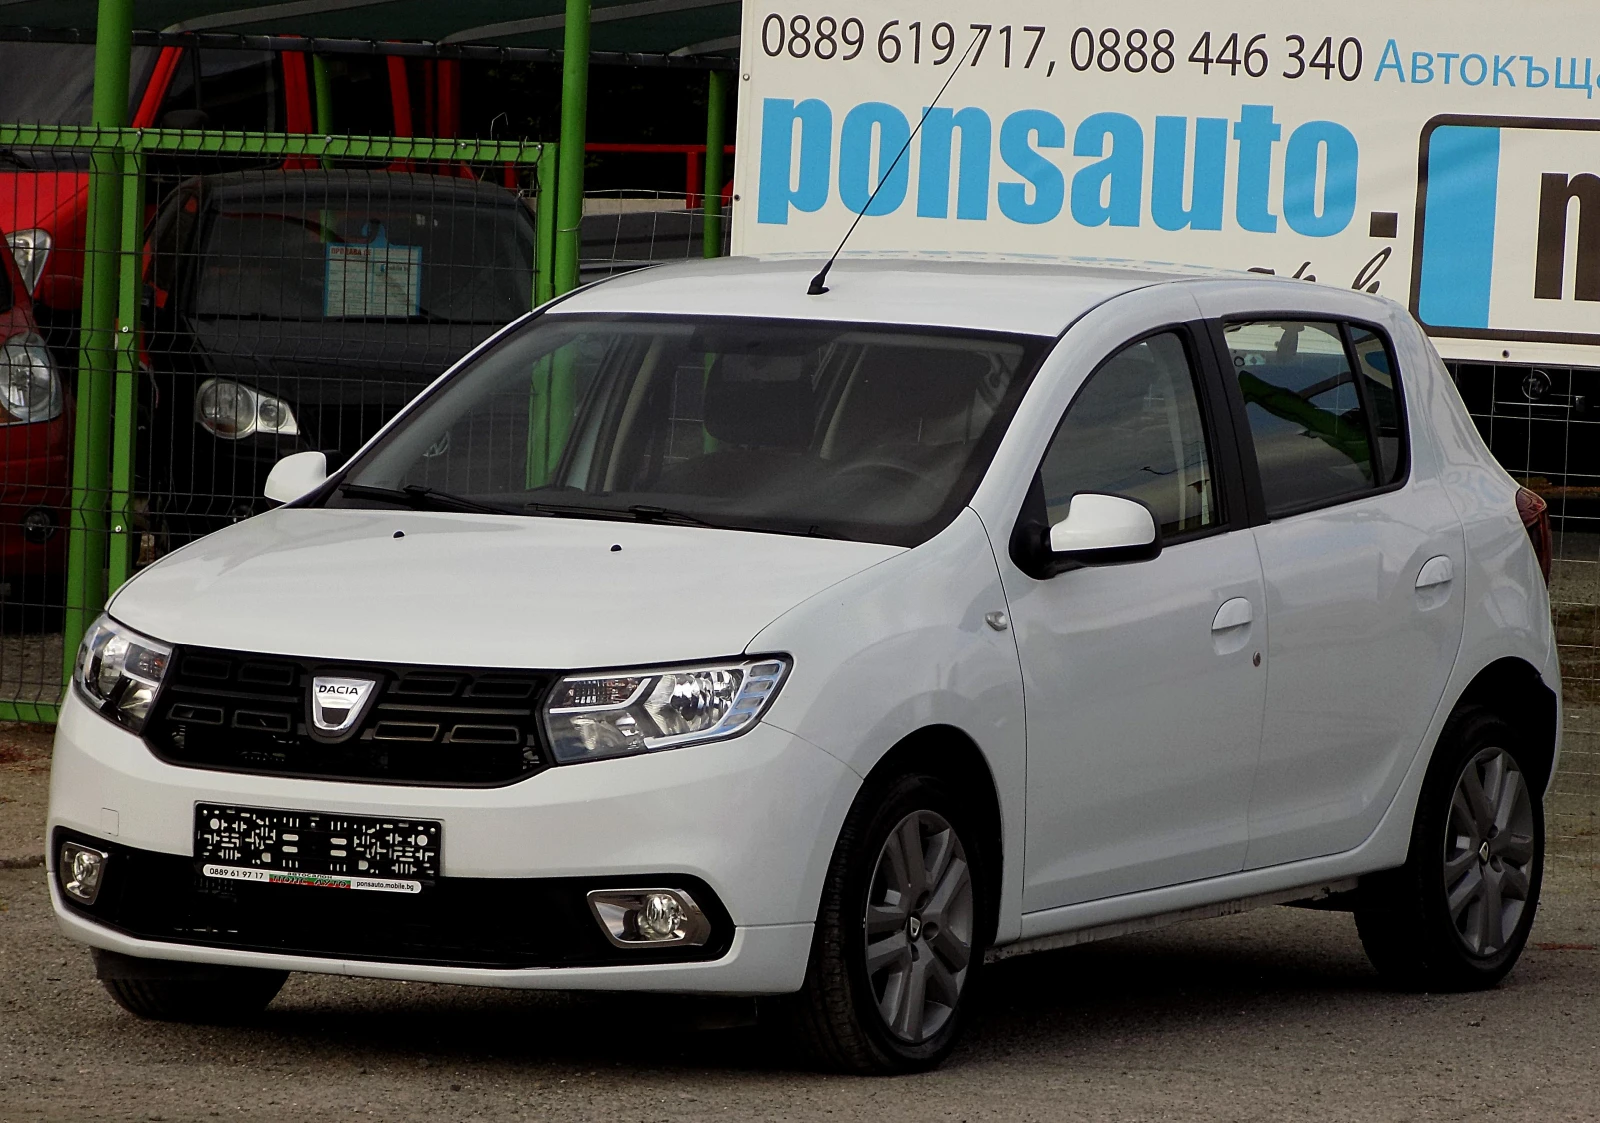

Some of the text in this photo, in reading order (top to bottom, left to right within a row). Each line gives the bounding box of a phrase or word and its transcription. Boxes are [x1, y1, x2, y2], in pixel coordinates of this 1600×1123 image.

[762, 13, 1363, 82] 0889 619 717, 0888 446 340
[1373, 38, 1600, 99] Автокъщ
[318, 685, 359, 695] DACIA
[209, 867, 229, 876] 0889
[242, 870, 252, 879] 97
[356, 880, 414, 891] ponsauto.mobile.bg
